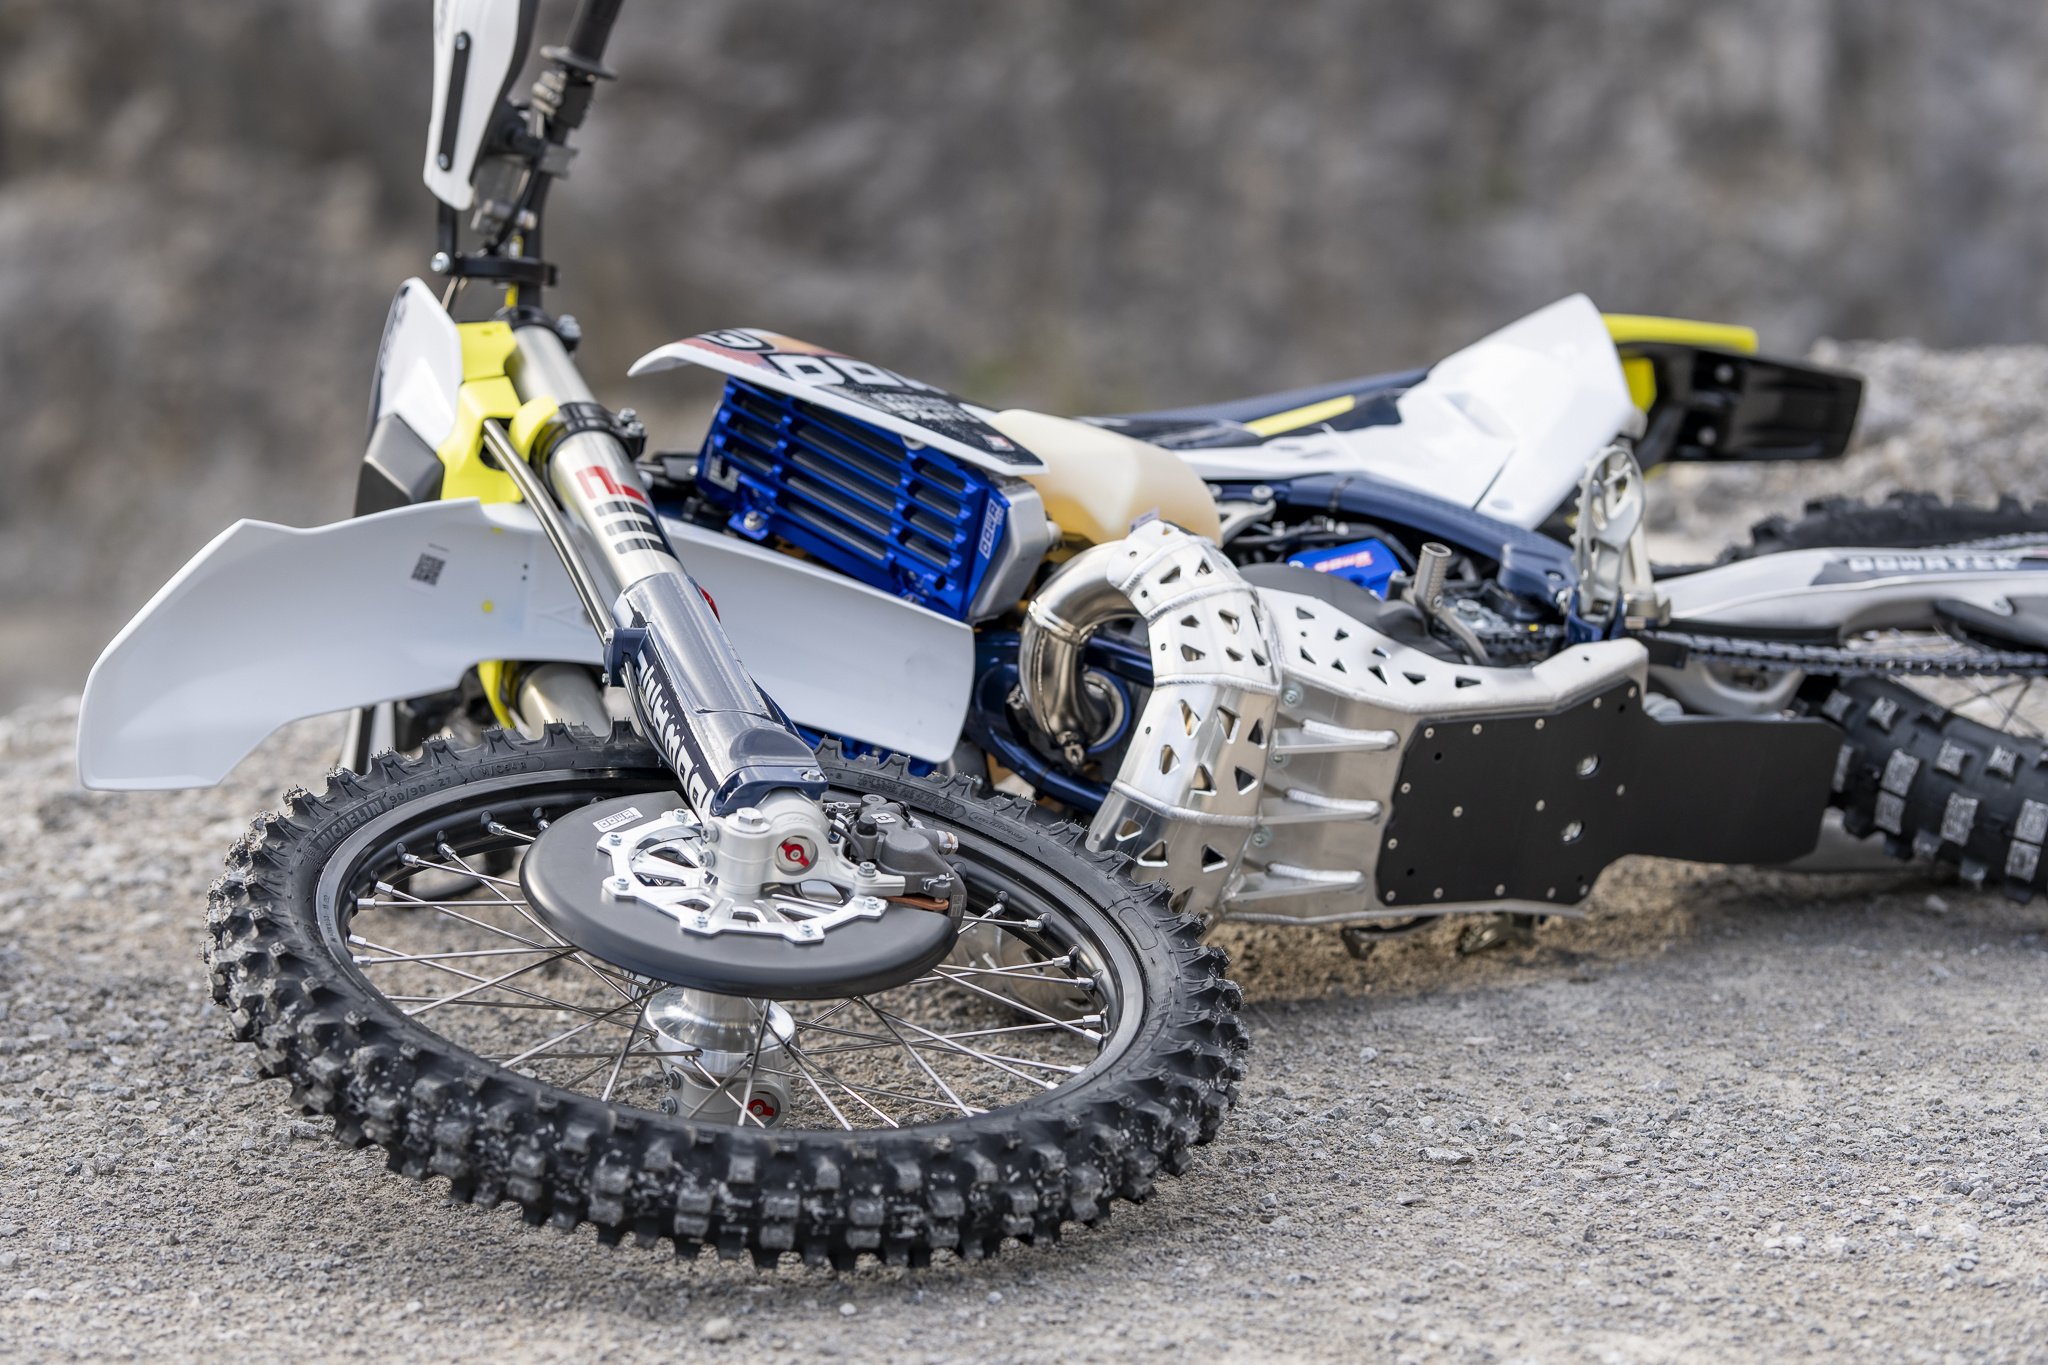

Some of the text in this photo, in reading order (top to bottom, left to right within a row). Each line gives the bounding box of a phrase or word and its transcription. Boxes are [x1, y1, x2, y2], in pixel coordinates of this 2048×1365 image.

[317, 800, 384, 850] MICHELIN
[389, 784, 427, 804] 90/90
[437, 776, 451, 787] 21
